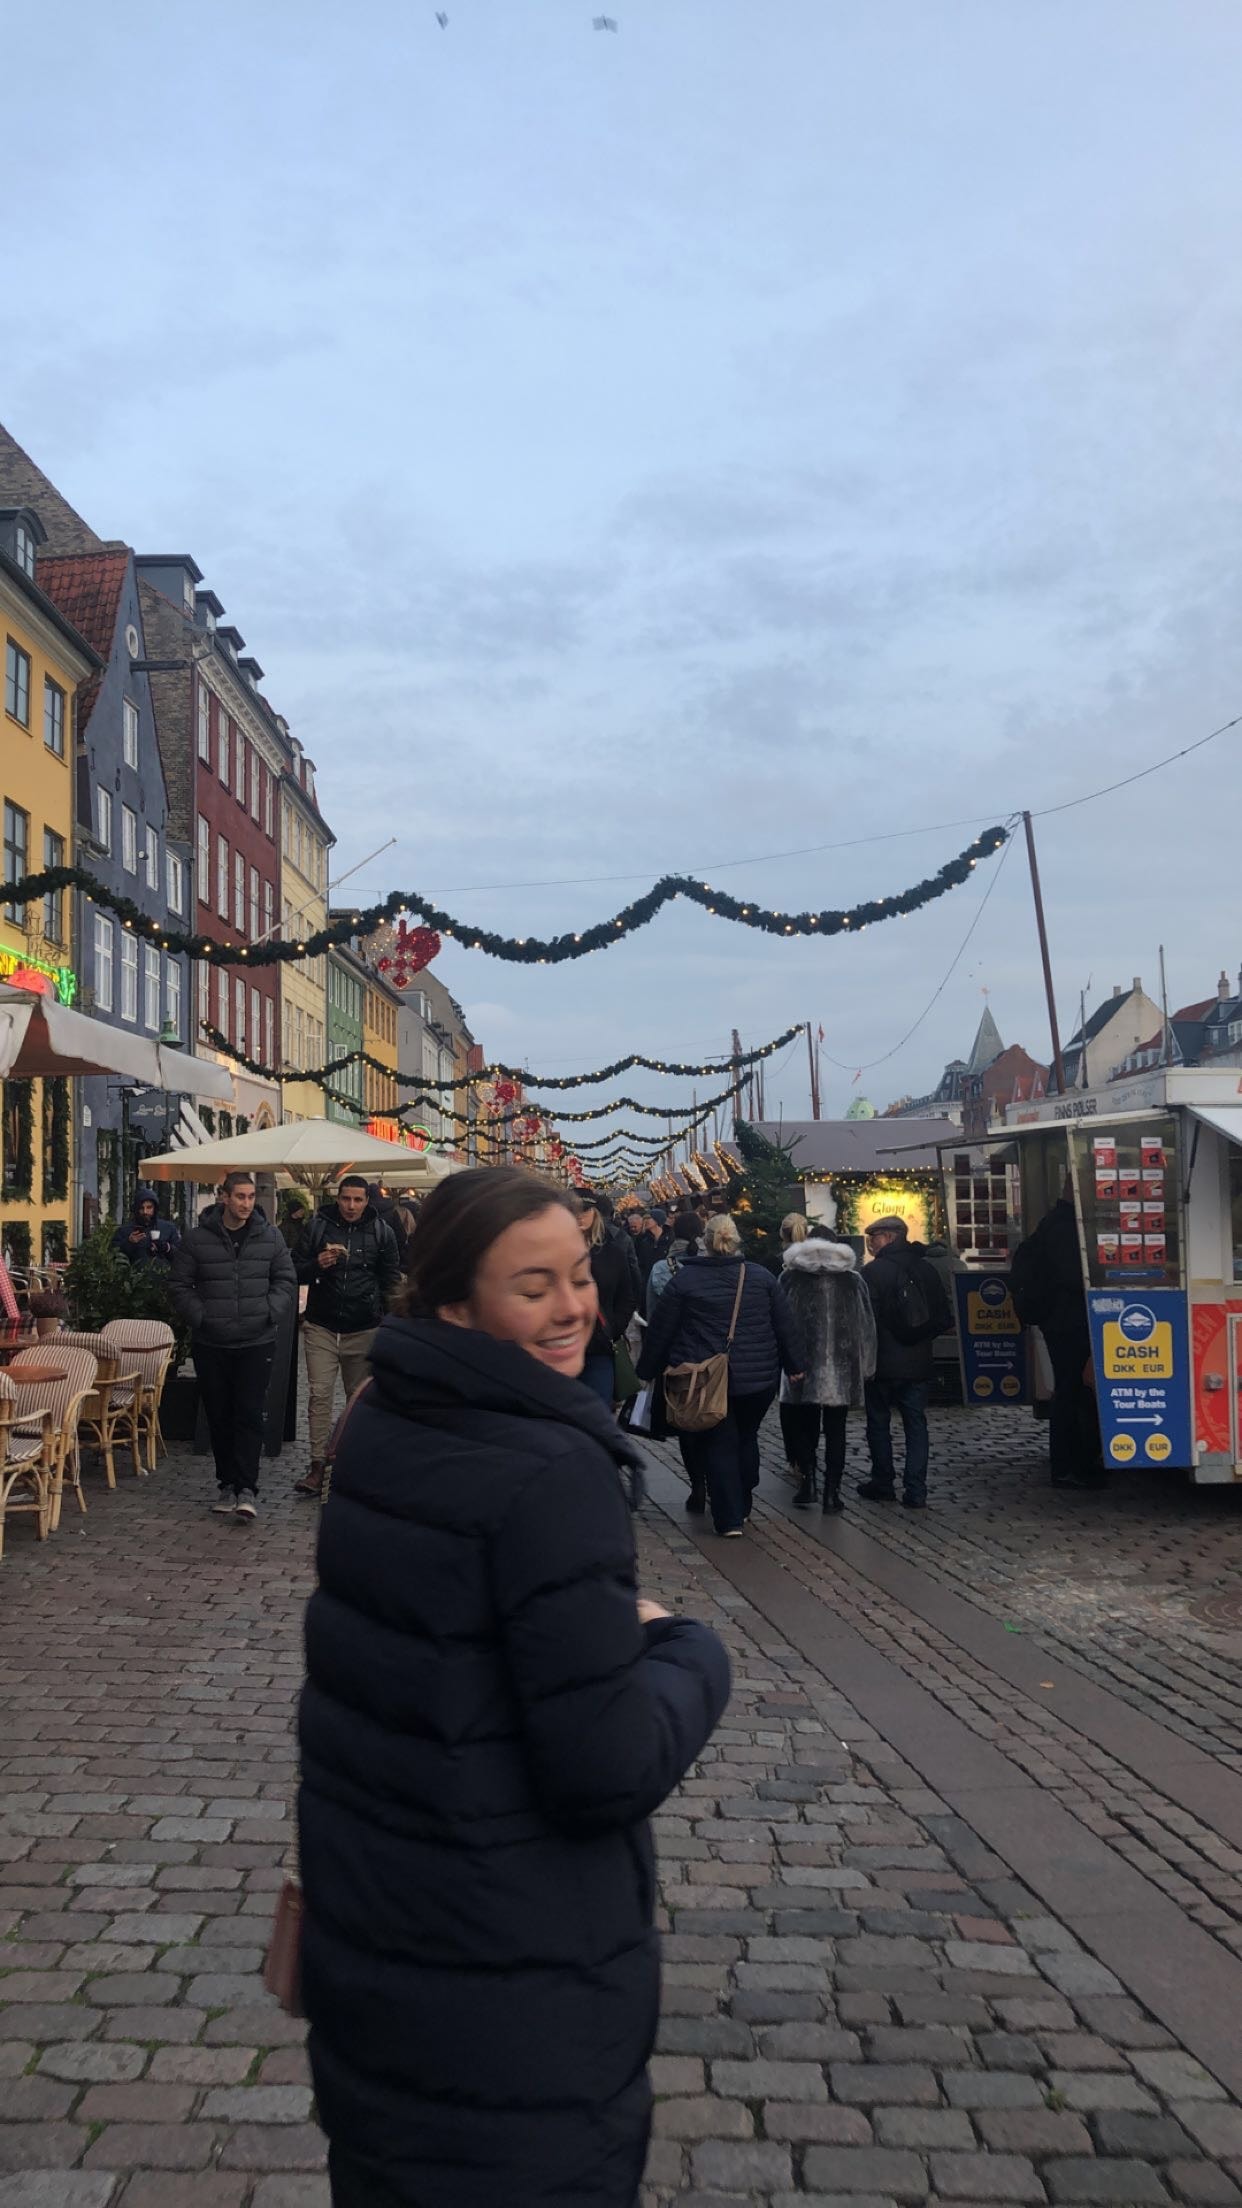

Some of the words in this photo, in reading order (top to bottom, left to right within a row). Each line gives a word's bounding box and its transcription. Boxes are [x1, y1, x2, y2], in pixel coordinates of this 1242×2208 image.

[977, 1310, 1011, 1319] CASH
[1116, 1347, 1159, 1358] CASH
[1113, 1364, 1135, 1373] DKK
[1143, 1364, 1165, 1373] EUR
[1111, 1388, 1133, 1397] ATM
[1135, 1388, 1147, 1398] by
[1149, 1388, 1166, 1397] the
[1113, 1400, 1136, 1409] Tour
[1138, 1400, 1166, 1409] Boats
[1112, 1443, 1133, 1452] DKK
[1149, 1443, 1168, 1451] EUR
